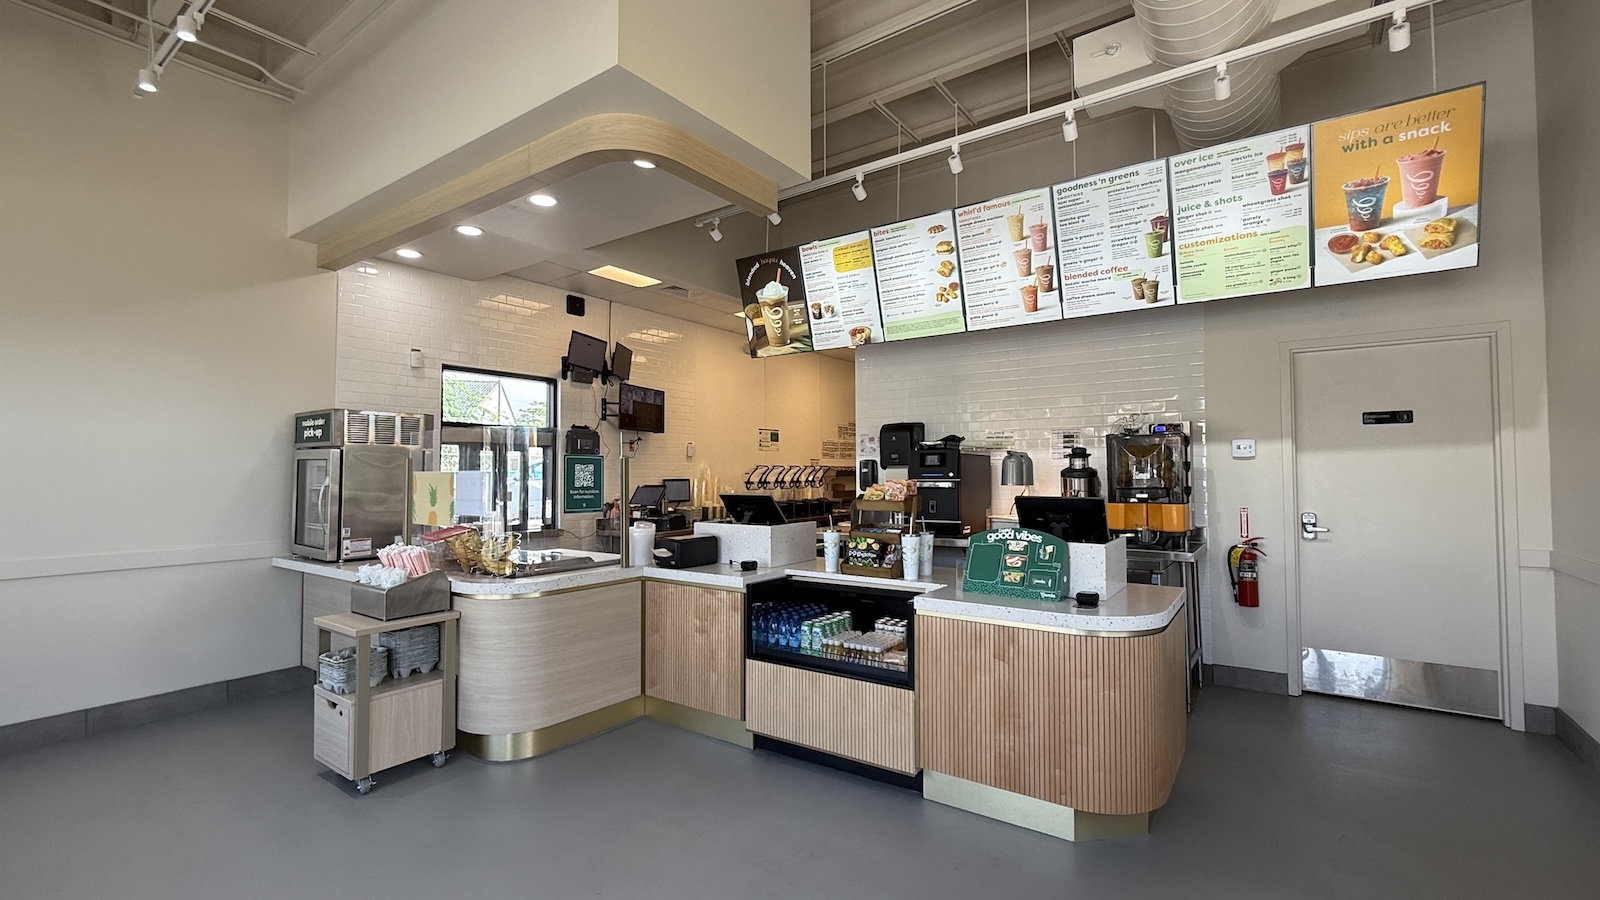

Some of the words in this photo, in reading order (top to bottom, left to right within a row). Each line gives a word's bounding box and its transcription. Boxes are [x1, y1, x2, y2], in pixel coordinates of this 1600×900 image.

[1338, 126, 1369, 143] sips
[1374, 121, 1403, 133] are
[1406, 109, 1455, 126] better
[1341, 137, 1377, 153] with
[1382, 134, 1394, 145] a
[1398, 121, 1451, 141] snack
[1174, 158, 1196, 168] over
[1199, 154, 1213, 162] ice
[1231, 154, 1252, 162] electric
[1057, 181, 1097, 196] goodness
[1108, 171, 1139, 183] greens
[958, 206, 981, 217] whirl'd
[983, 201, 1010, 211] famous
[1177, 204, 1201, 215] juice
[1214, 195, 1242, 206] shots
[1242, 198, 1276, 207] wheatgrass
[1179, 232, 1257, 250] customizations
[745, 261, 760, 286] blended
[779, 258, 797, 280] heaven
[1064, 269, 1098, 280] blended
[1100, 266, 1128, 275] coffee
[304, 428, 322, 439] pick-up
[987, 530, 1014, 543] good
[1015, 531, 1042, 543] vibes
